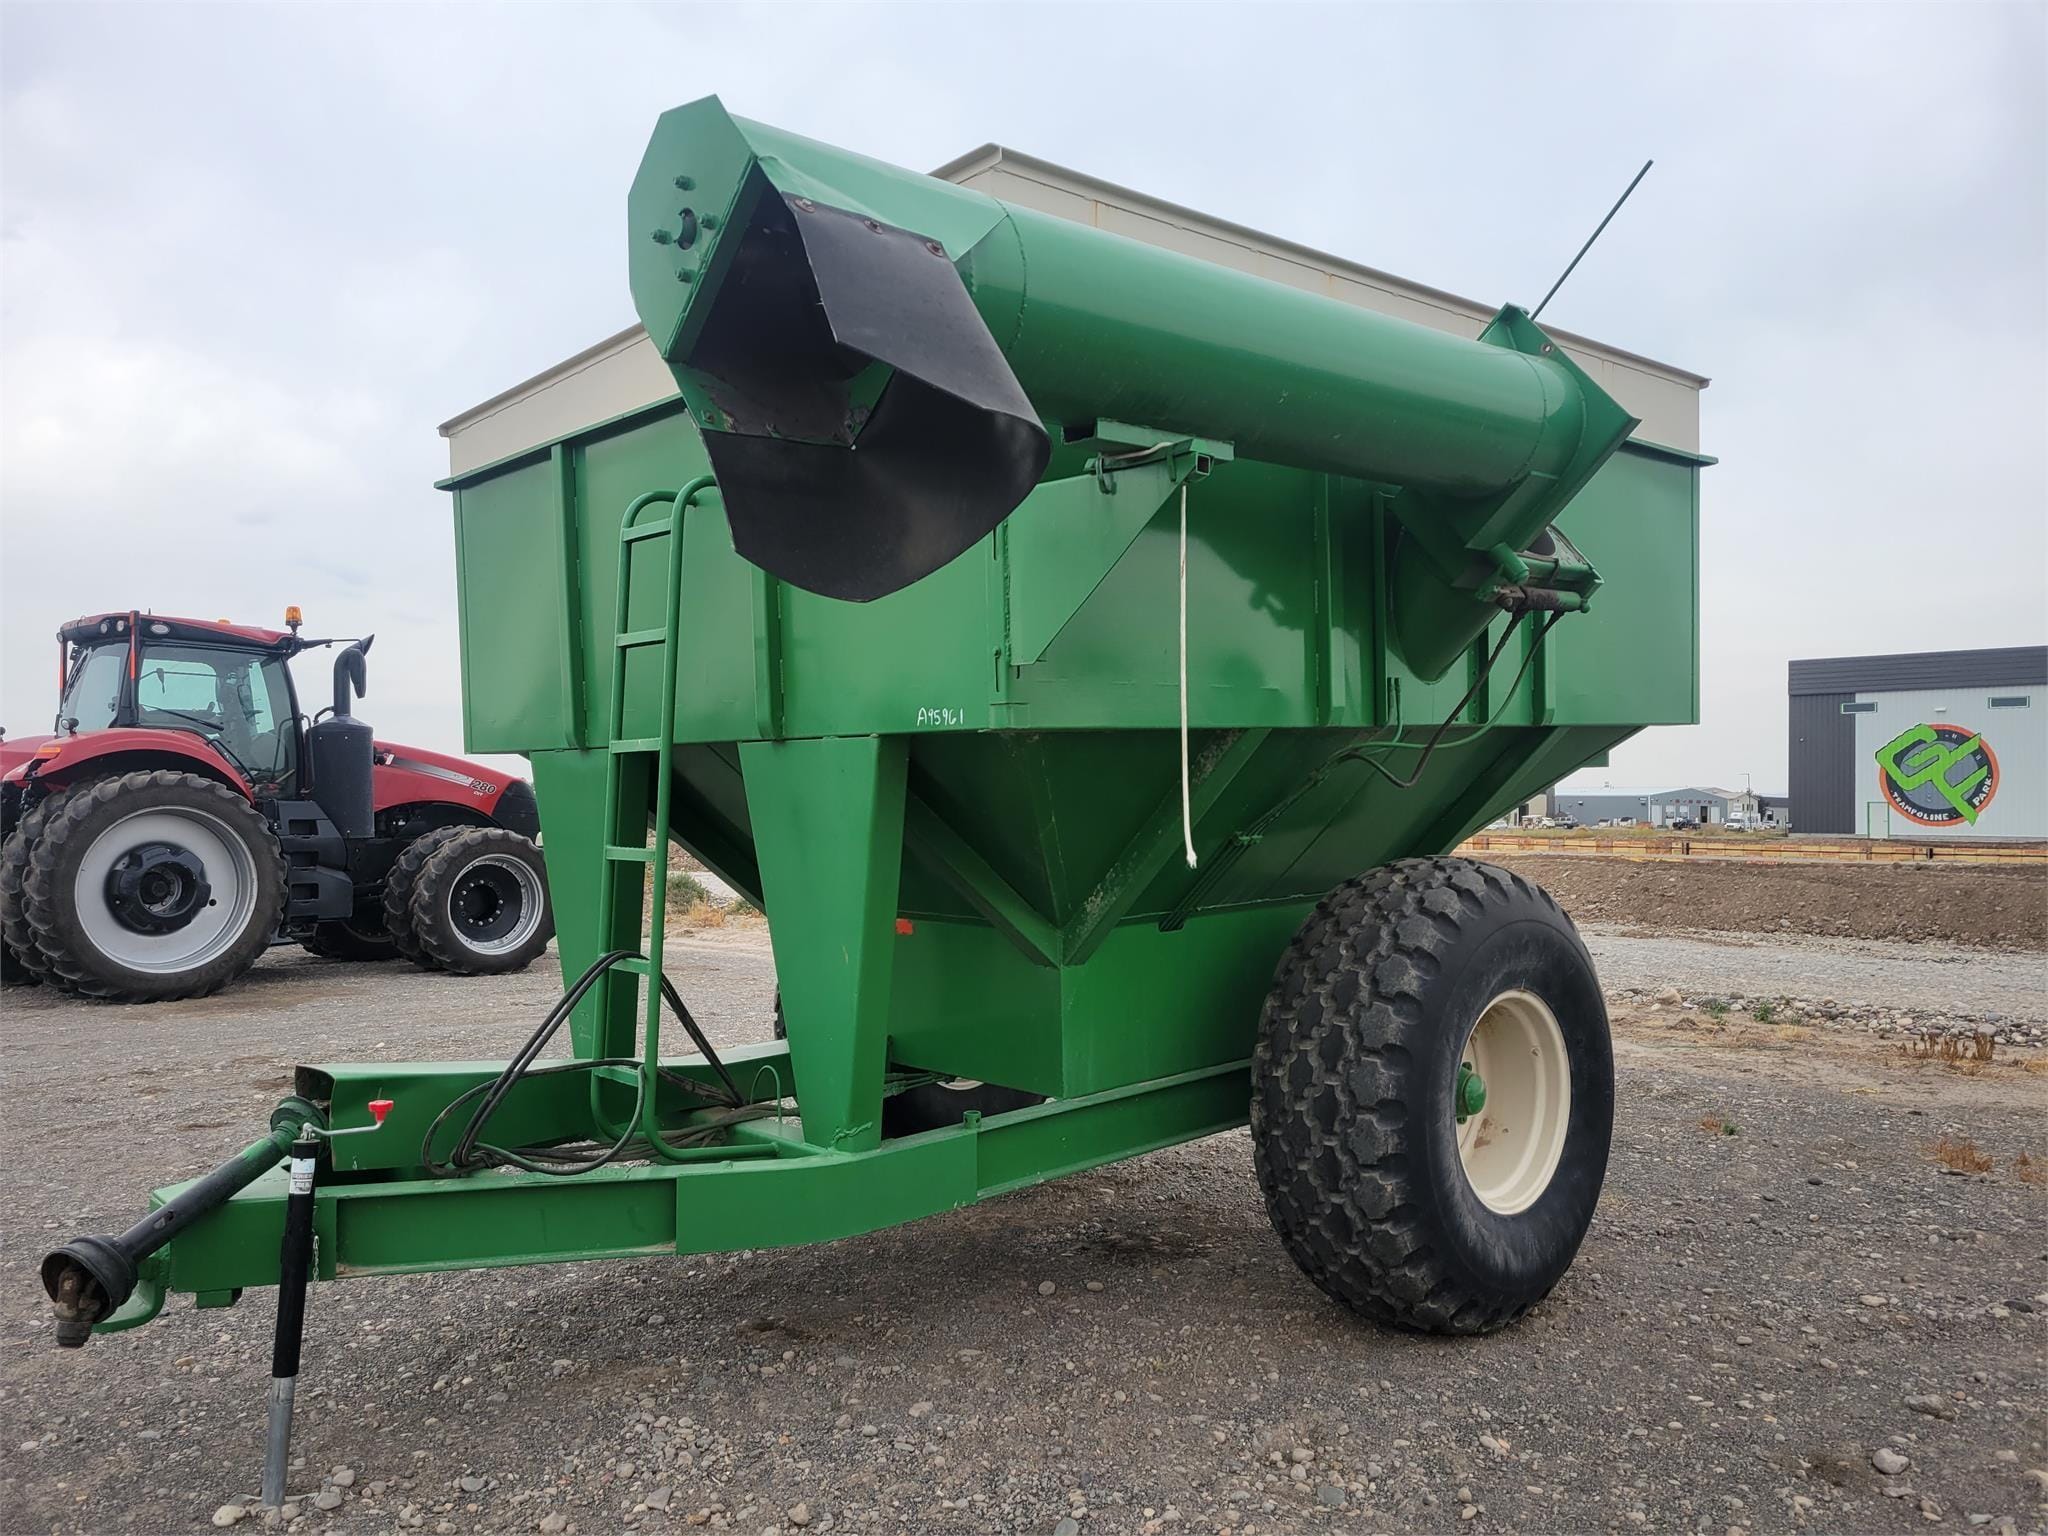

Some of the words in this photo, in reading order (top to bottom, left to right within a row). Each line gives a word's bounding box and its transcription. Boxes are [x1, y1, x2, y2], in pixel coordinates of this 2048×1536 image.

[917, 707, 963, 726] A95961
[471, 780, 496, 794] 280
[1892, 791, 1950, 821] TRAMPOLINE
[1972, 777, 1992, 806] PARK
